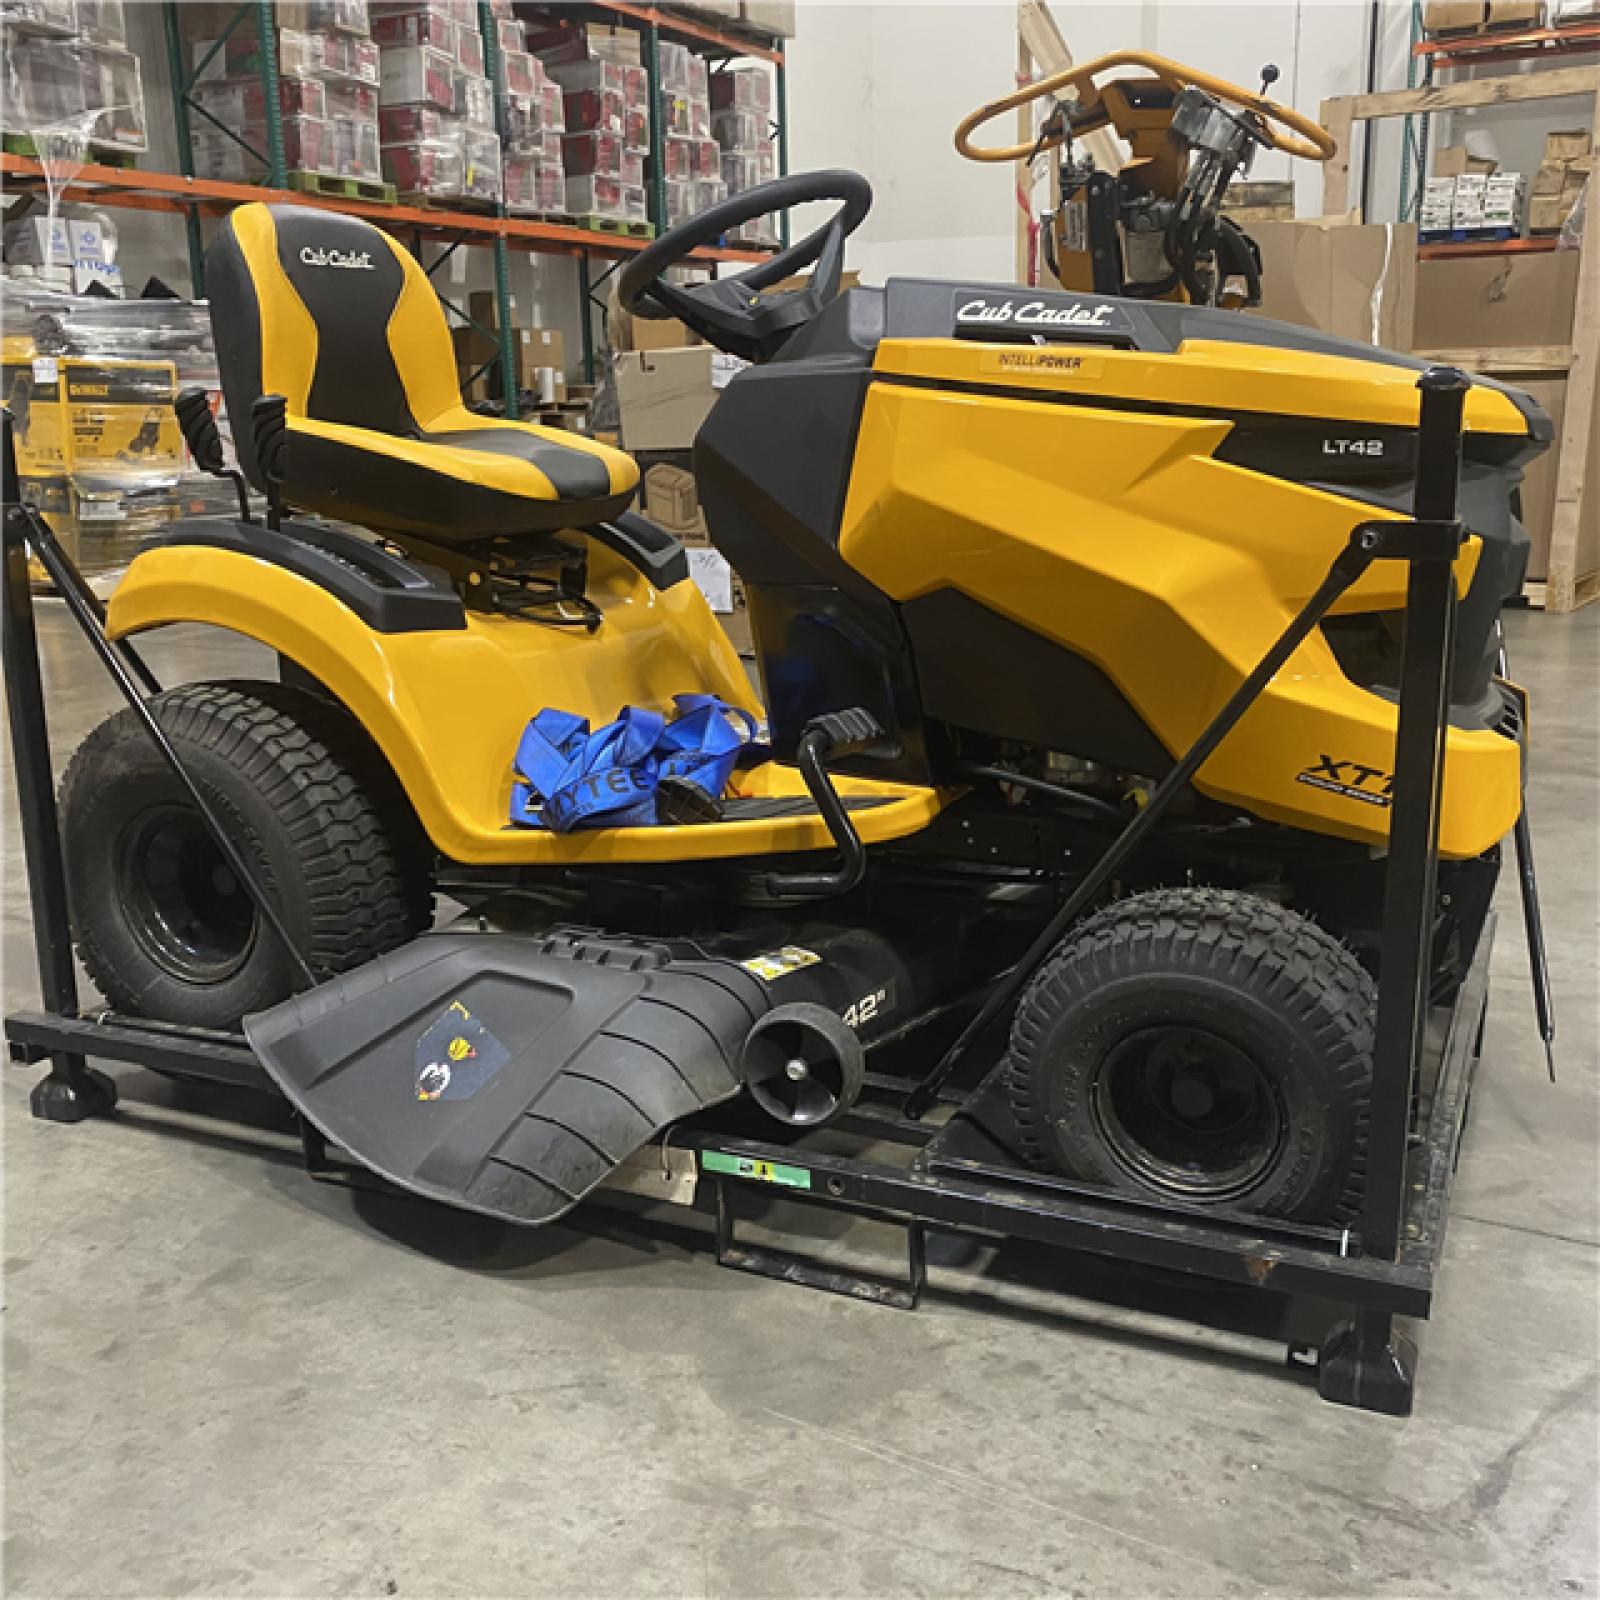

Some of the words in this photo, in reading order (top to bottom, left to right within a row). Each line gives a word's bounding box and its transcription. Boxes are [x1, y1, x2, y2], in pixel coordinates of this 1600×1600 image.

[957, 300, 1014, 321] Cub
[1014, 302, 1114, 326] Cadet
[999, 353, 1082, 369] INTELLIPOWER
[1322, 439, 1384, 456] LT42
